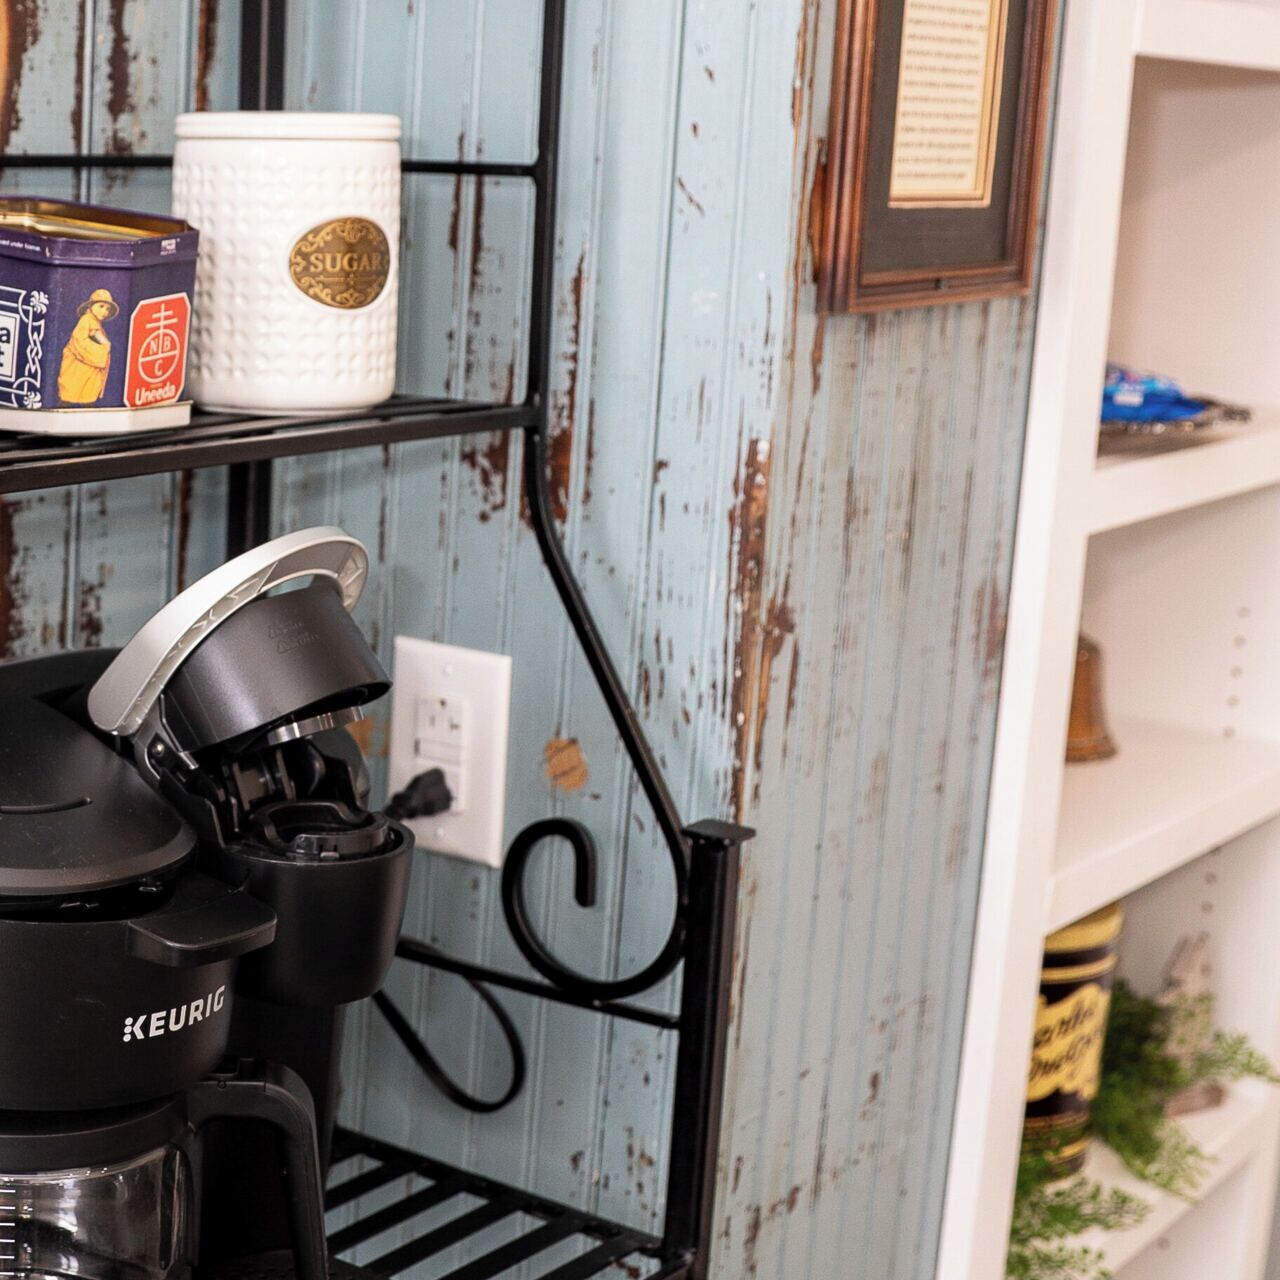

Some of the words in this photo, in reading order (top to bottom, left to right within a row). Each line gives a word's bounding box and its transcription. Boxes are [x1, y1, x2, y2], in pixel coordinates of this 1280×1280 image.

[309, 252, 382, 273] SUGAR
[135, 382, 177, 406] Uneeda
[123, 985, 226, 1042] KEURIG
